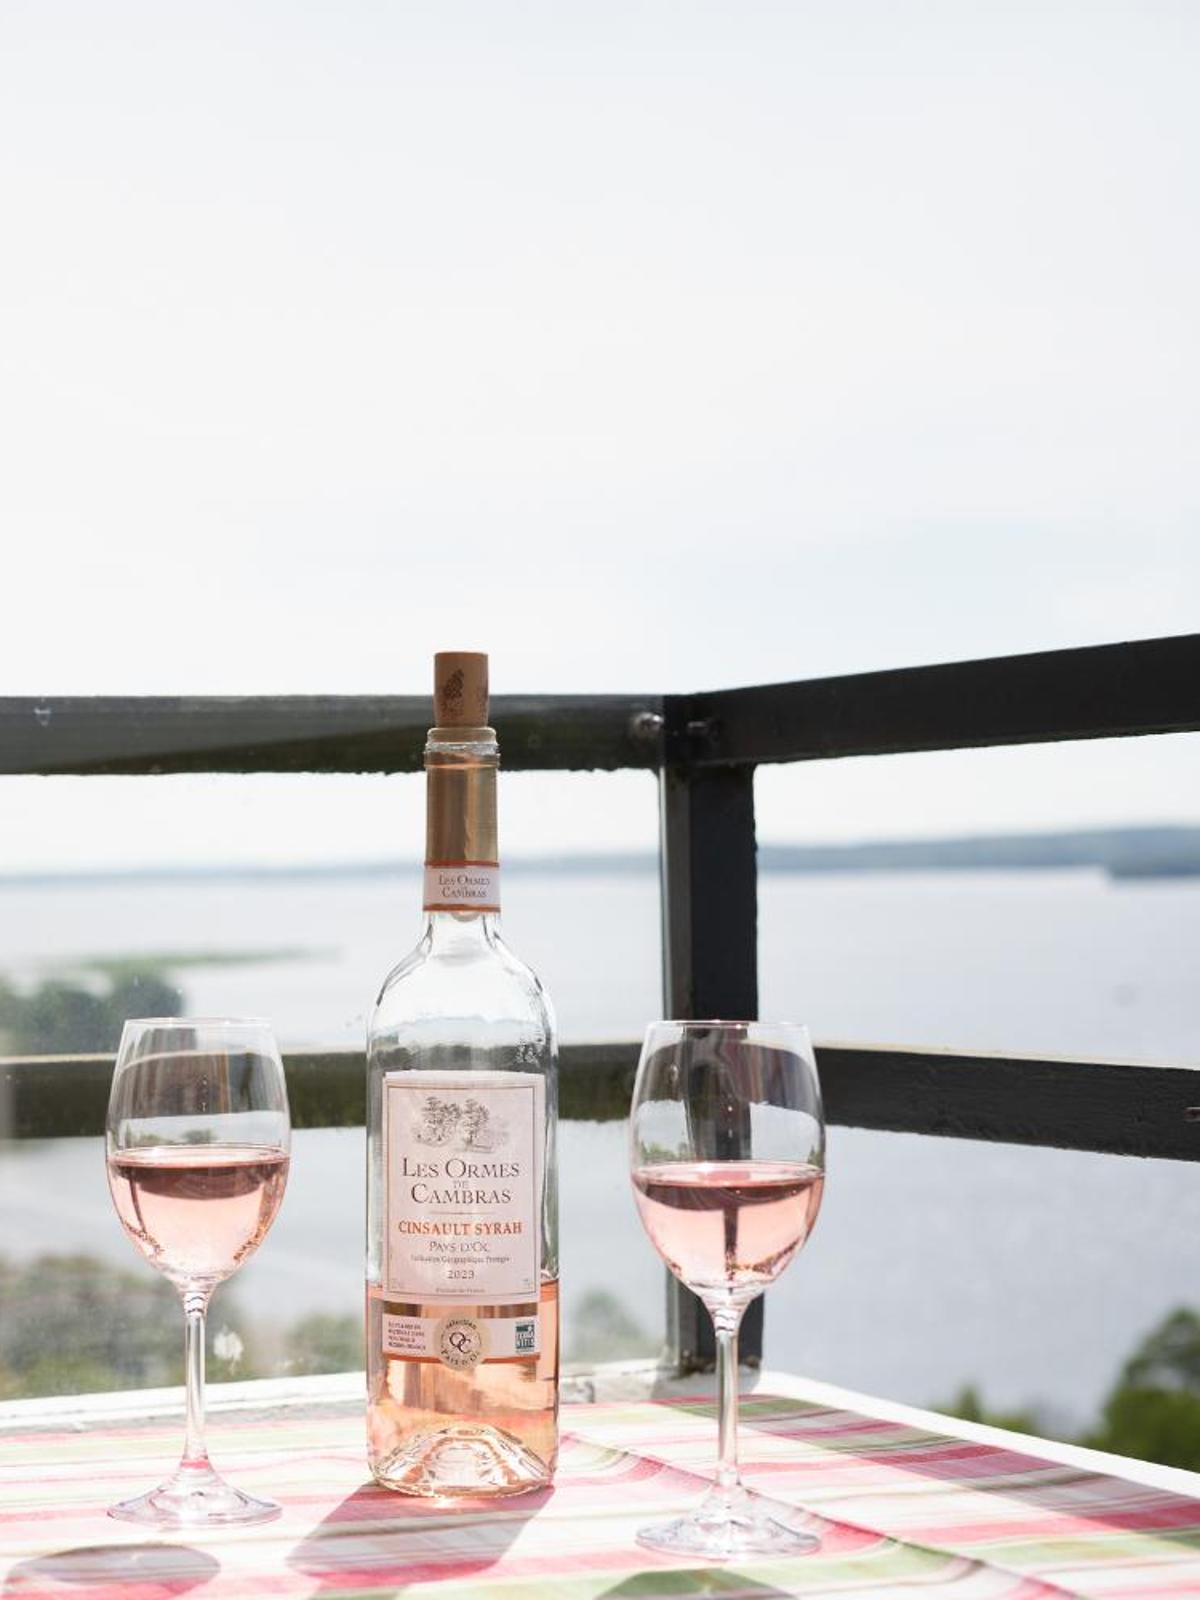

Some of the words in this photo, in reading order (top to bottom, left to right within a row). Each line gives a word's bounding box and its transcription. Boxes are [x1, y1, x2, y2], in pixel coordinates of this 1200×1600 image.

[402, 1157, 439, 1178] LES
[445, 1158, 520, 1178] ORMES
[453, 1180, 469, 1189] DE
[411, 1183, 512, 1204] CAMBRAS
[399, 1220, 471, 1236] CINSAULT
[475, 1222, 522, 1236] SYRAH
[429, 1241, 456, 1253] PAYS
[448, 1270, 475, 1279] 2023
